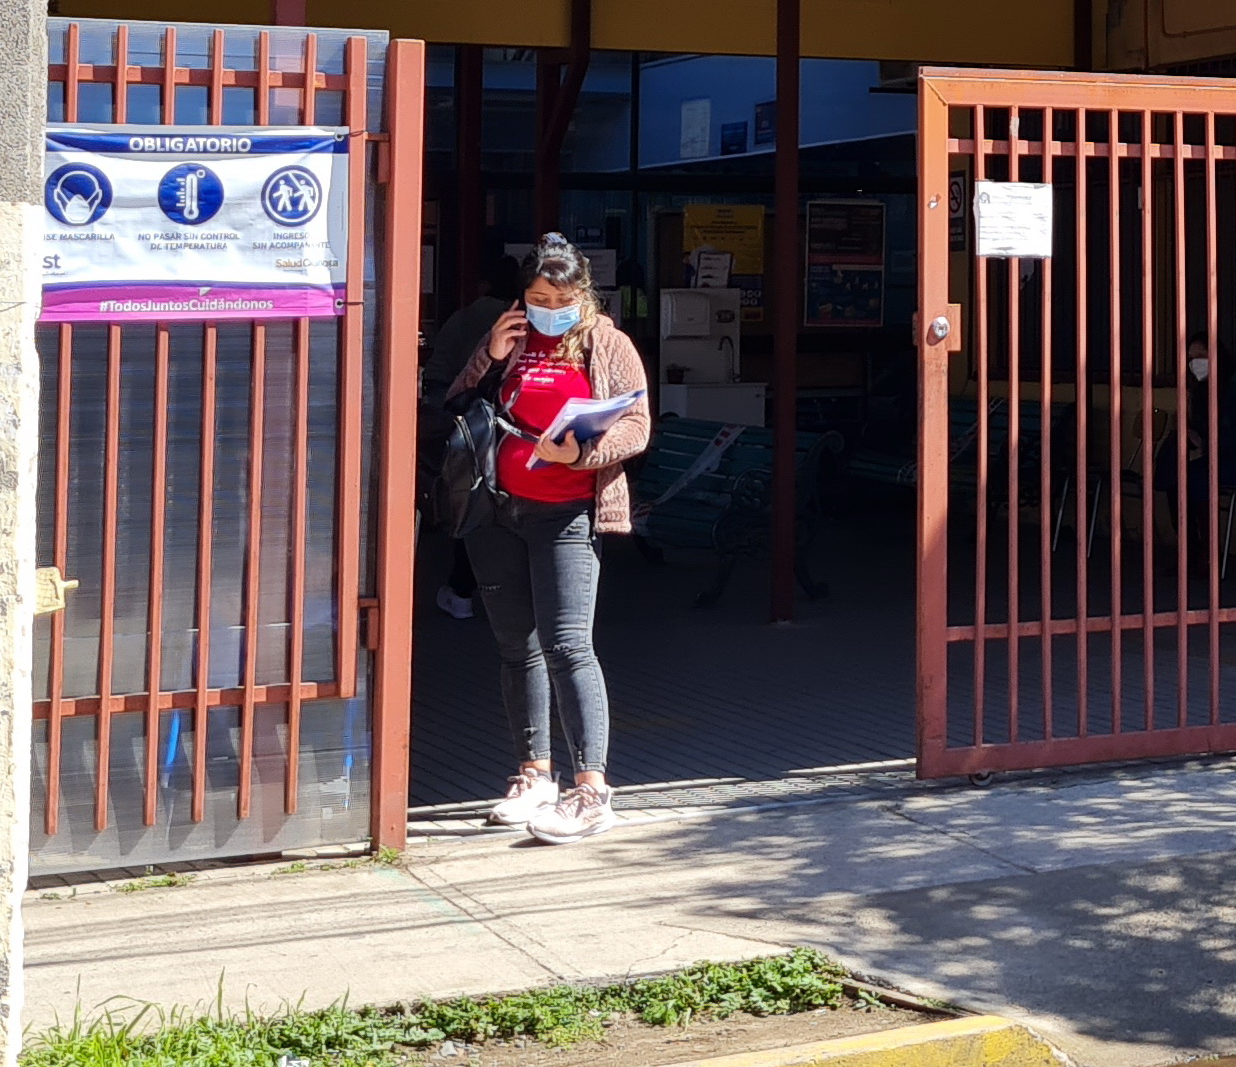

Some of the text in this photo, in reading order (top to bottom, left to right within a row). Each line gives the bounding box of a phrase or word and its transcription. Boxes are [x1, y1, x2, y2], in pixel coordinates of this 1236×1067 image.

[128, 137, 252, 154] OBLIGATORIO
[59, 232, 115, 241] MASCARILLA
[138, 232, 240, 241] NO PASAR SIN CONTROL
[150, 242, 228, 250] DE TEMPERATURA
[252, 242, 268, 250] SIN
